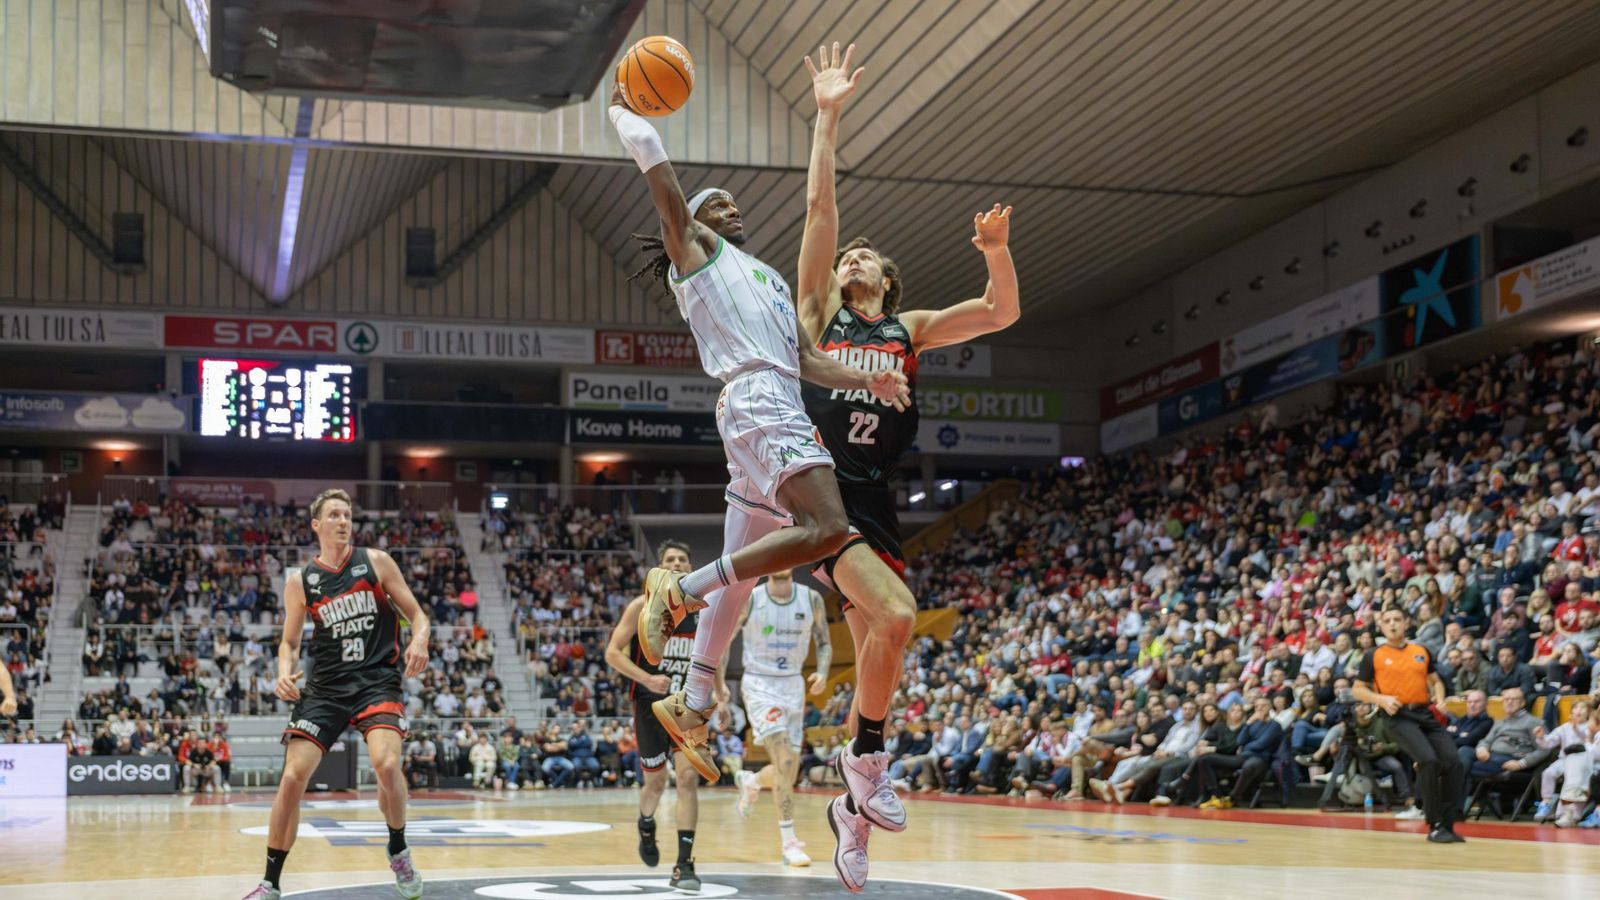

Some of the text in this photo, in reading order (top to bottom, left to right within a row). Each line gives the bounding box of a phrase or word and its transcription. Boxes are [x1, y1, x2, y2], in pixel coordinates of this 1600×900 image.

[42, 312, 106, 343] TULSÀ
[213, 321, 338, 347] SPAR
[424, 329, 476, 355] LLEAL
[483, 330, 543, 358] TULSÀ
[573, 378, 669, 401] Panella
[576, 417, 624, 437] Kave
[628, 418, 683, 439] Home
[847, 410, 880, 445] 22
[317, 590, 378, 628] GIRONA
[331, 615, 376, 639] FIATC
[341, 637, 364, 661] 29
[776, 657, 787, 670] 2
[69, 759, 170, 782] endesa
